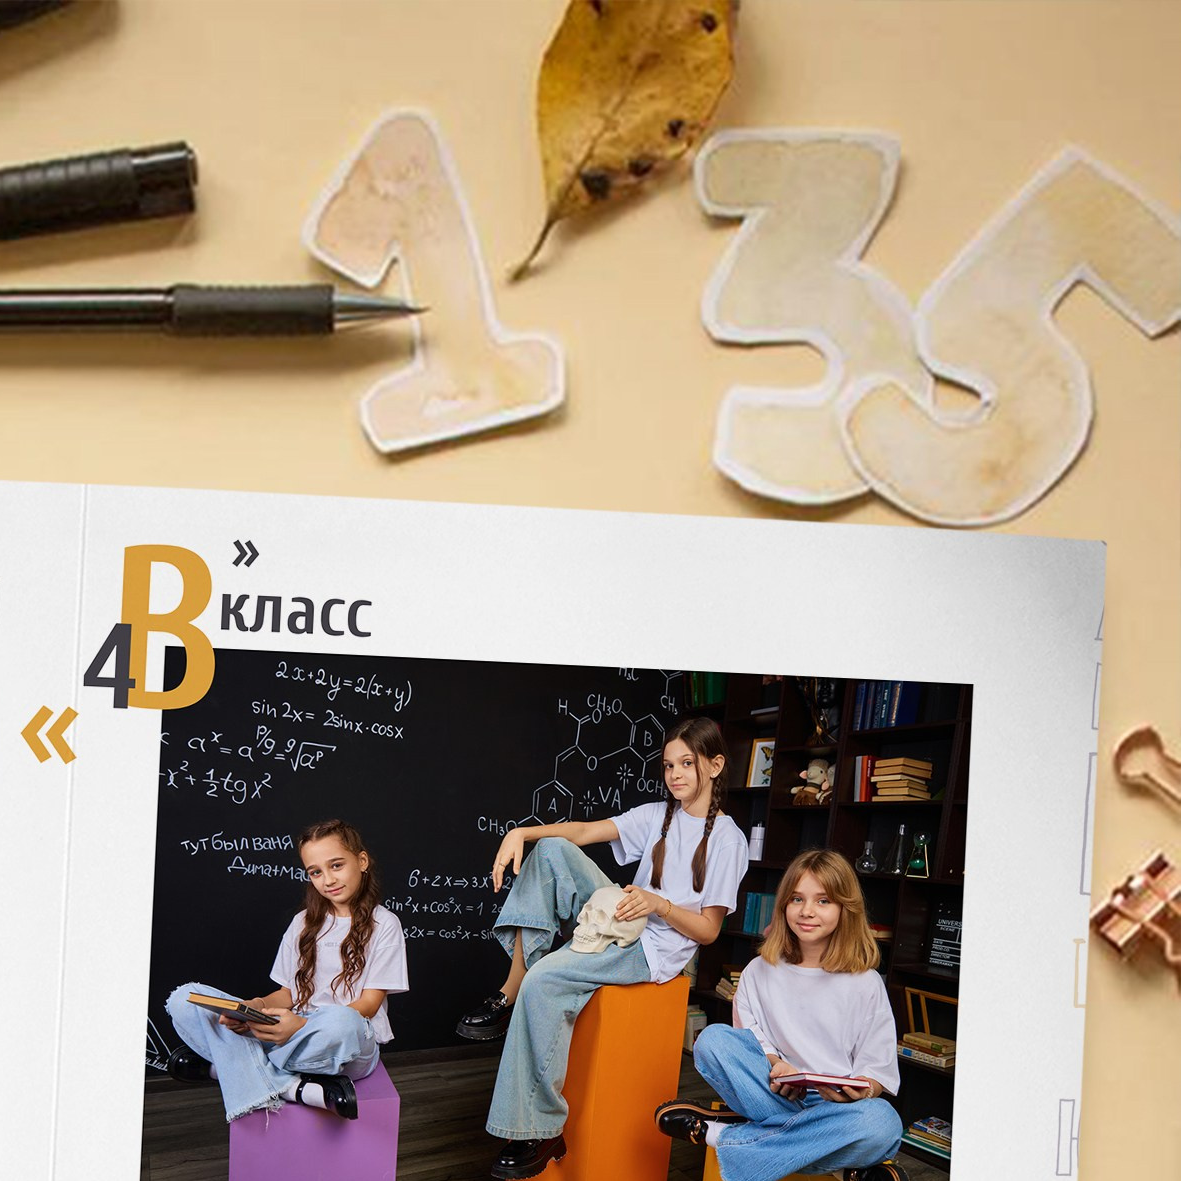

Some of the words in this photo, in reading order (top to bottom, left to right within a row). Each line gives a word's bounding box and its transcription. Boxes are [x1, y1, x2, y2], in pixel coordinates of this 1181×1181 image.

[220, 593, 373, 638] класс
[83, 623, 136, 709] 4
[211, 831, 249, 851] был
